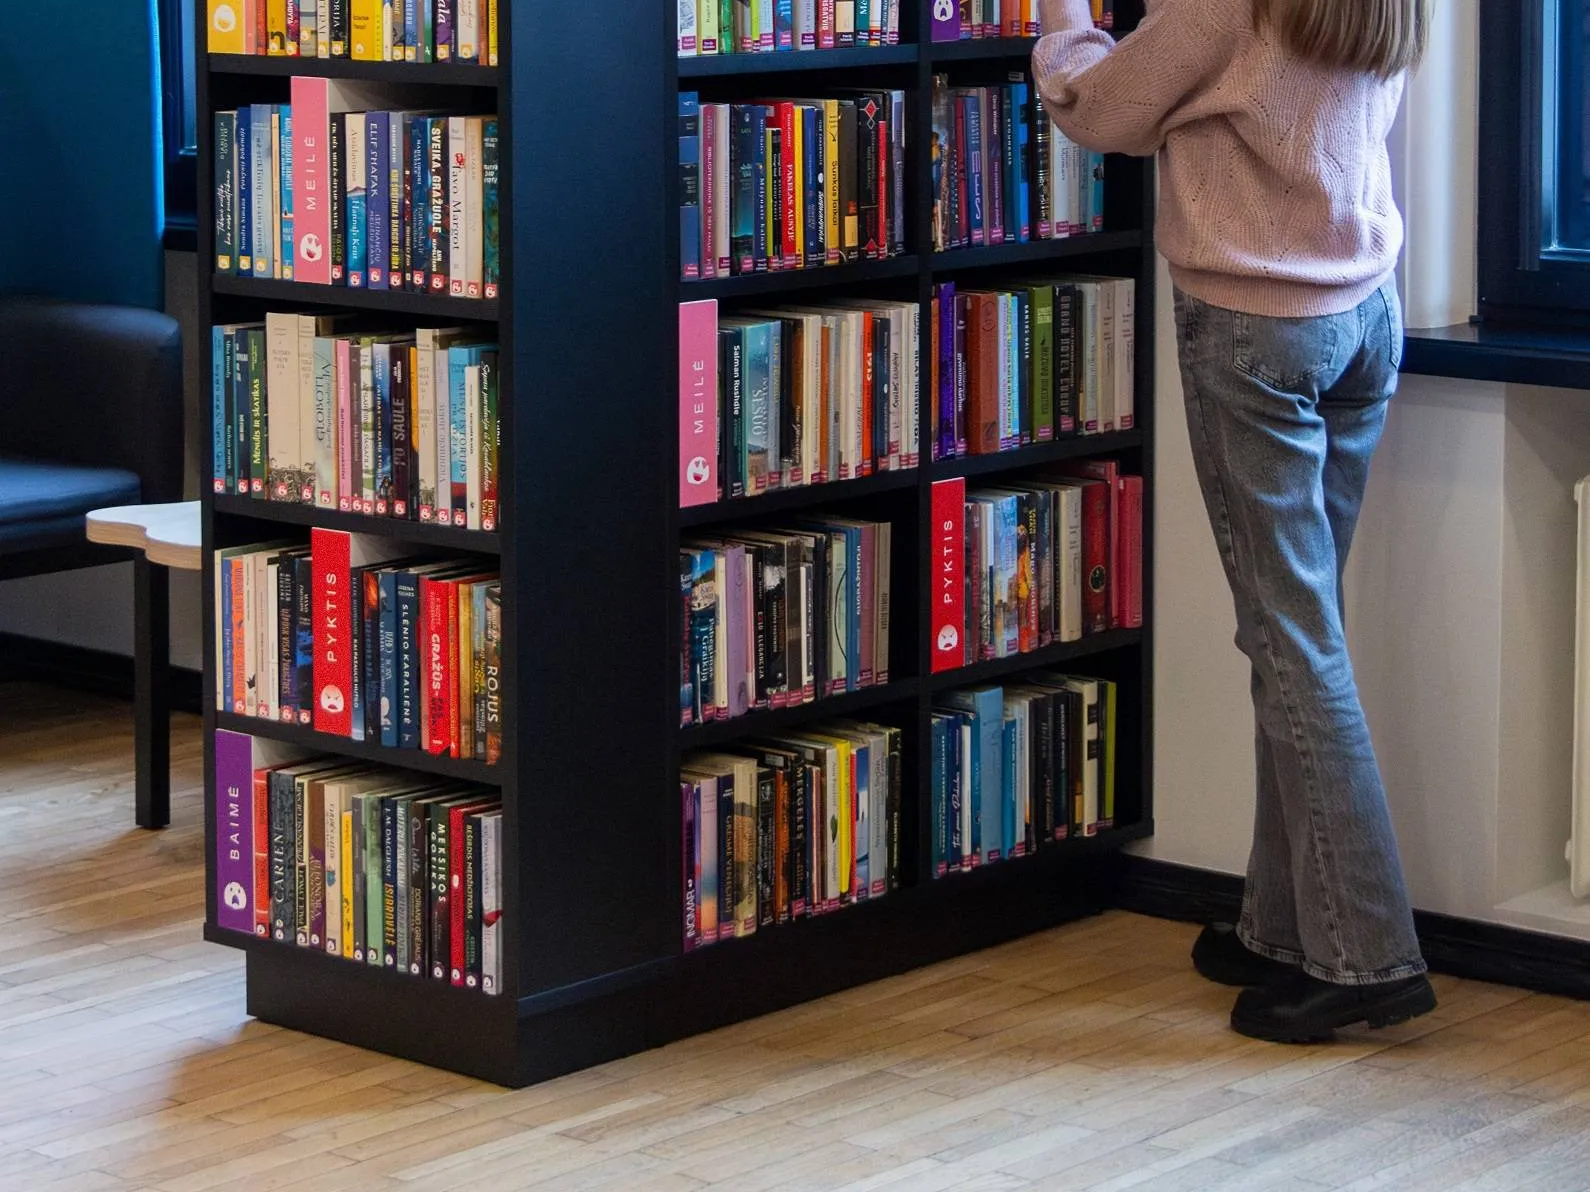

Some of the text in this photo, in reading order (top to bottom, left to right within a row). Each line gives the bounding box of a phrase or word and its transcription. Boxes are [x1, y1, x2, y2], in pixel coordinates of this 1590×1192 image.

[370, 123, 378, 147] ELIF
[303, 135, 316, 211] MEILĖ
[430, 127, 444, 233] SVEIKA, GRAŽUOLE
[449, 199, 464, 250] Margot
[692, 359, 704, 434] MEILĖ
[732, 344, 742, 416] Salman Rushdie
[942, 520, 953, 604] PYKTIS
[325, 573, 338, 663] PYKTIS
[403, 654, 413, 724] KARALIENĖ
[487, 665, 499, 723] ROJUS
[229, 786, 241, 861] BAIMĖ
[437, 823, 447, 903] MEKSIKOS
